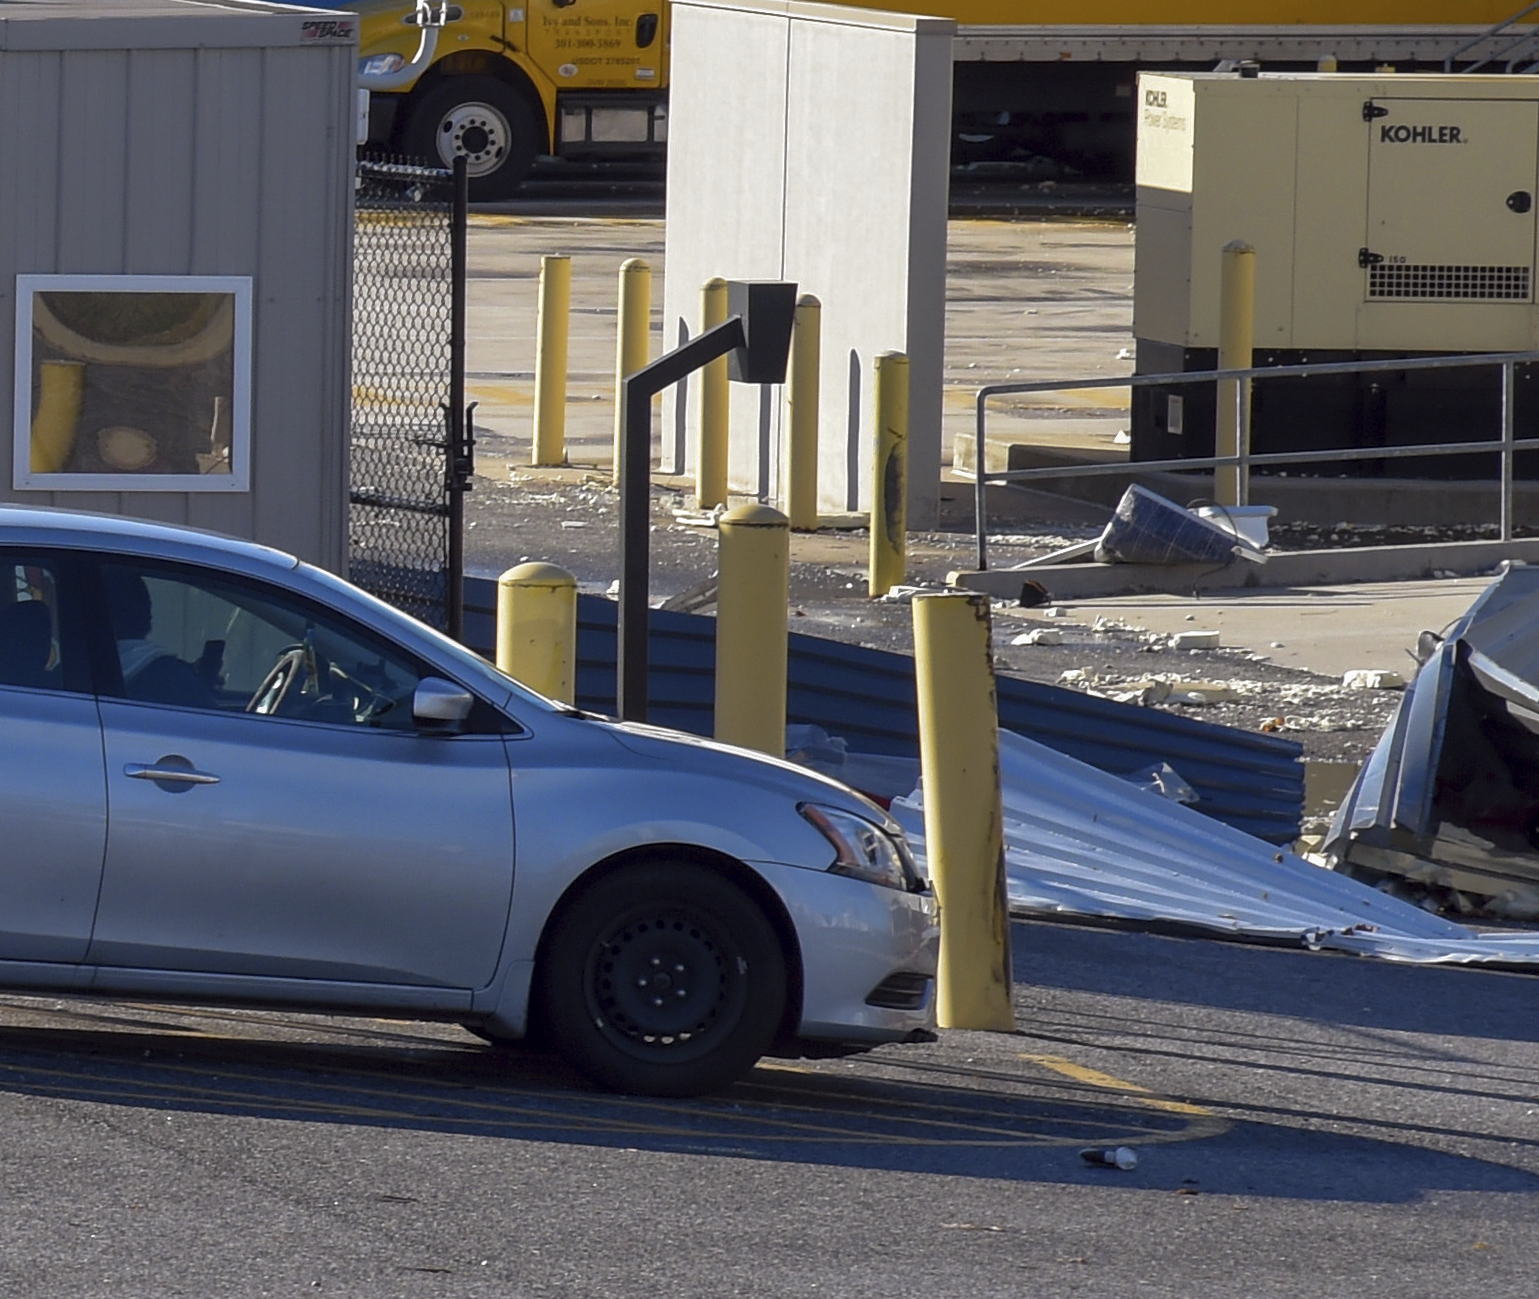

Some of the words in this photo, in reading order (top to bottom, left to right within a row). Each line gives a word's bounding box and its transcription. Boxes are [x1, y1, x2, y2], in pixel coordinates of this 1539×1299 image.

[302, 21, 337, 30] SPEED
[562, 16, 581, 26] and
[318, 29, 353, 38] SPACE
[572, 57, 602, 65] USDOT
[1381, 125, 1462, 143] KOHLER
